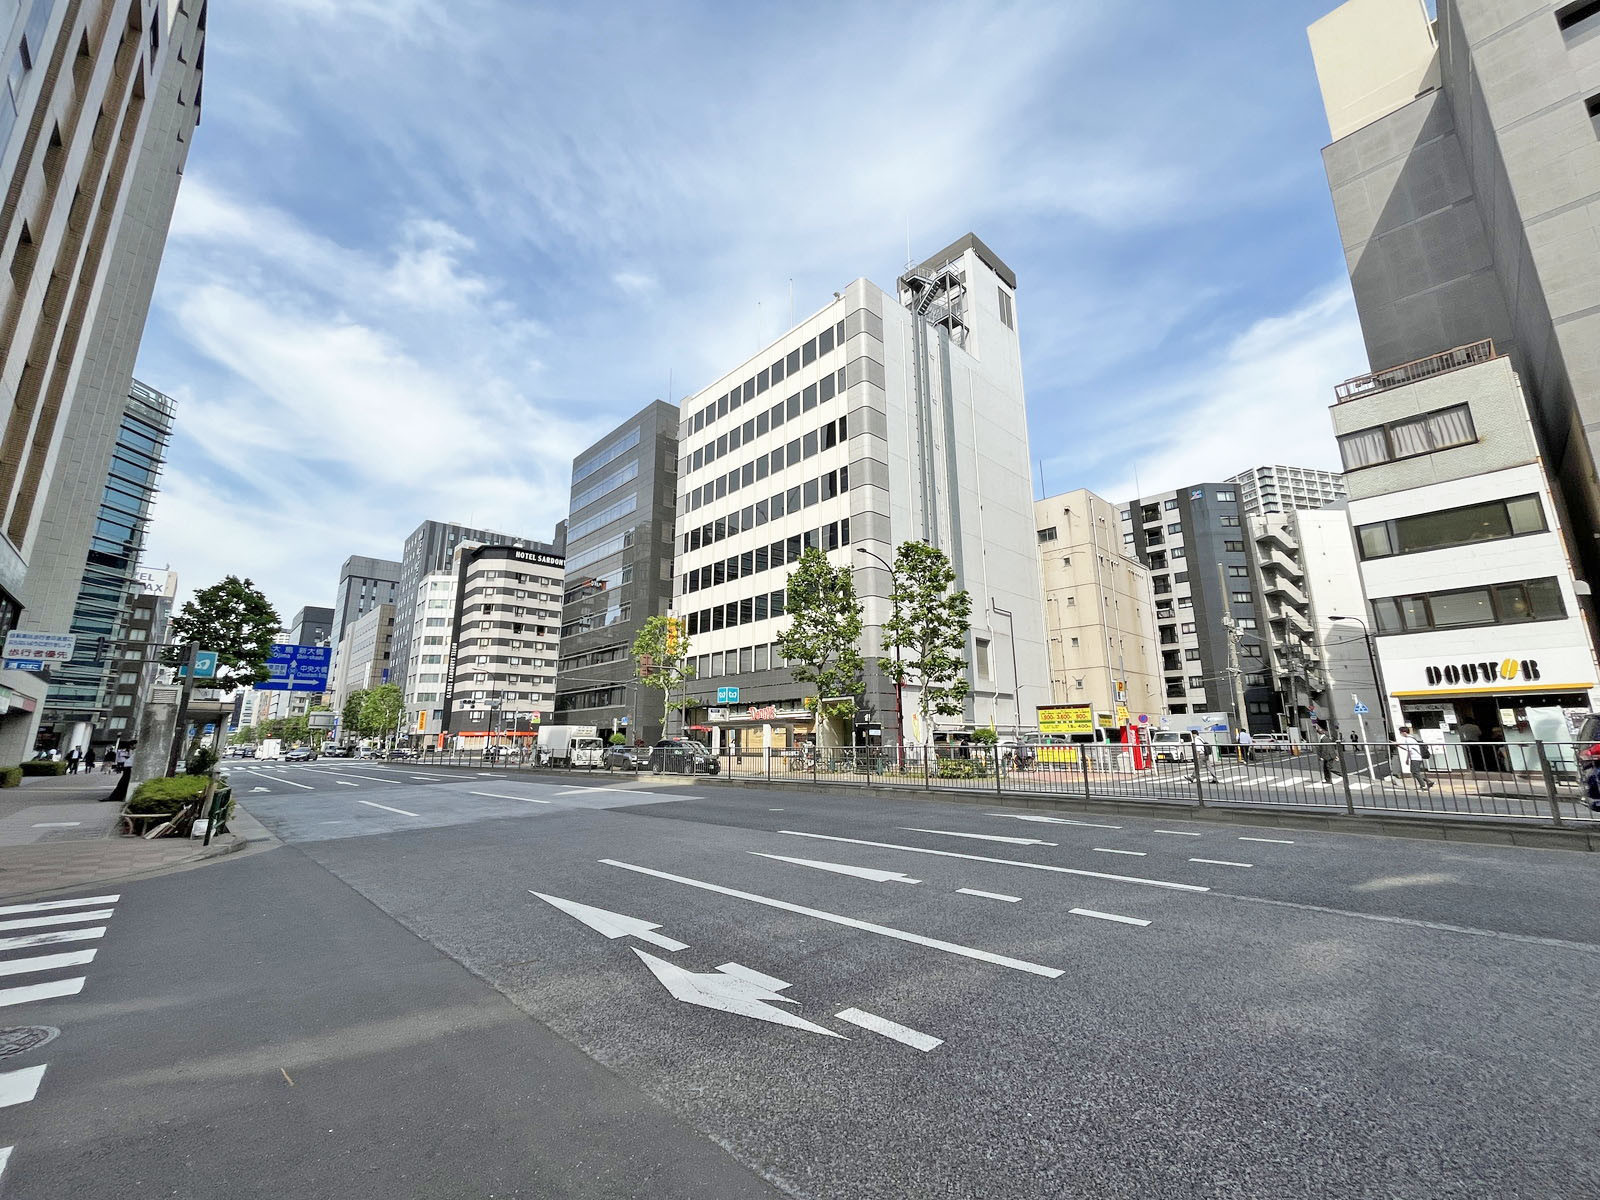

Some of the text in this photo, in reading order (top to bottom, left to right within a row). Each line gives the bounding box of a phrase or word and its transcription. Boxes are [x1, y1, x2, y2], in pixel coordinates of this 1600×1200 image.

[515, 551, 537, 561] HOTEL
[8, 648, 68, 658] 歩行者優先
[1425, 658, 1541, 686] DOUTOR
